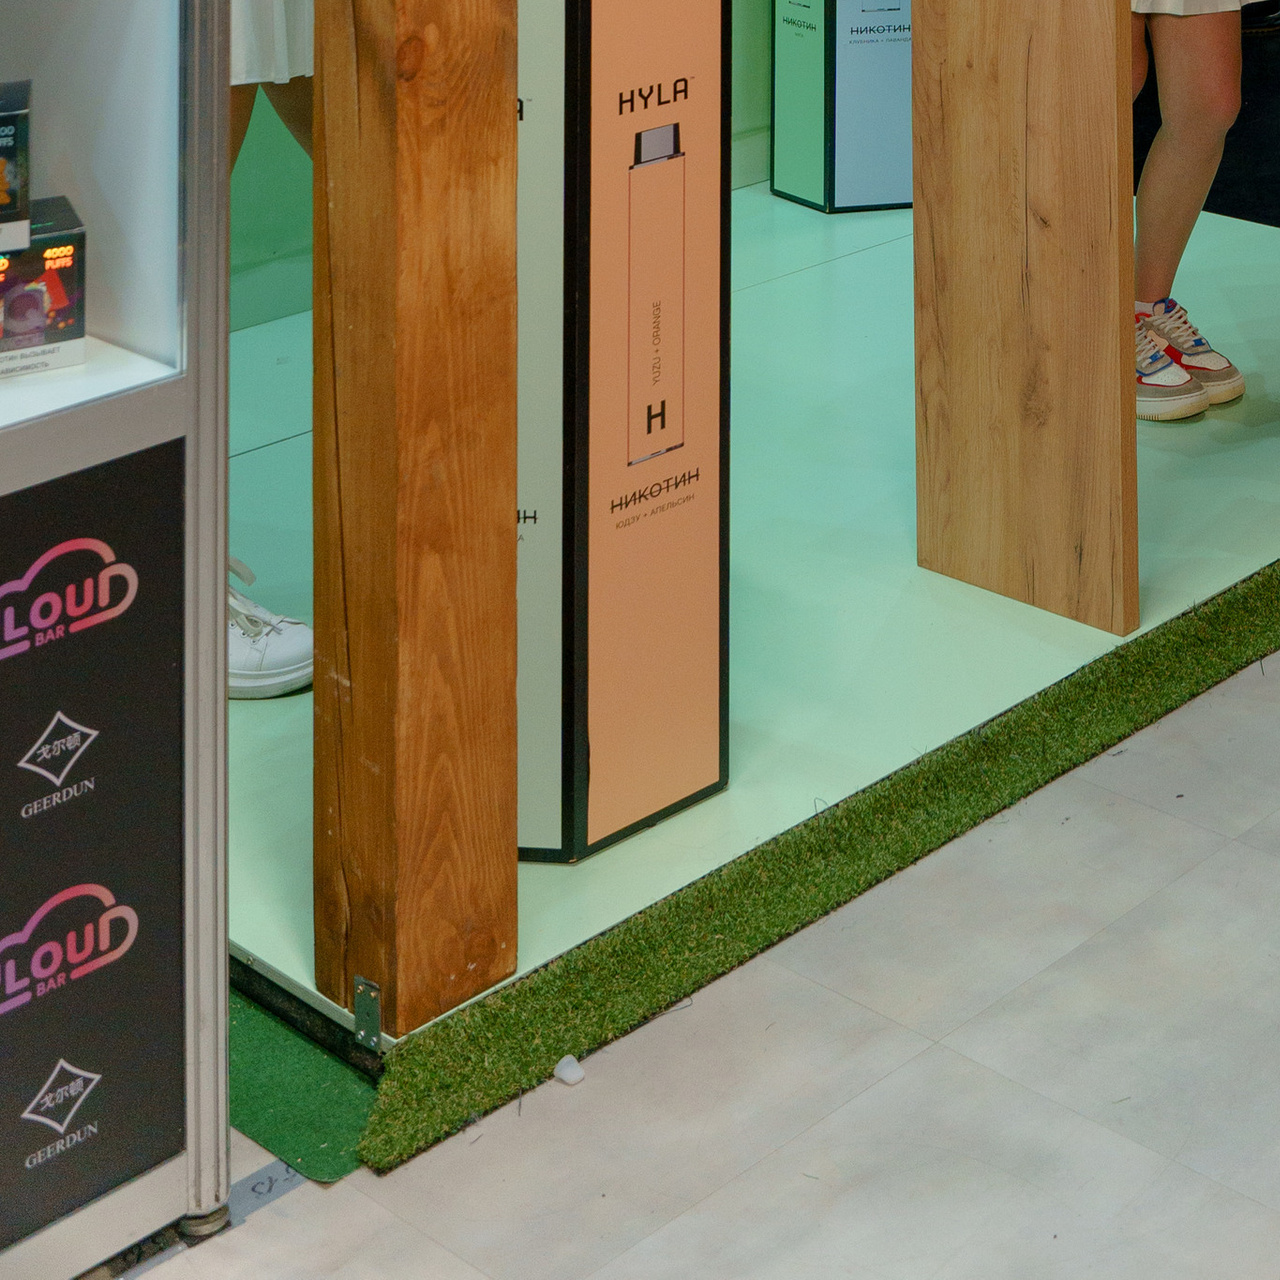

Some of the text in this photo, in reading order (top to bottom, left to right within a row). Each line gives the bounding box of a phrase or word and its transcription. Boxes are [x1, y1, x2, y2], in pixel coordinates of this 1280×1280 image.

[782, 16, 817, 32] НИКОТИН
[850, 24, 911, 35] НИКОТИН
[618, 77, 690, 116] HYLA
[43, 245, 75, 259] 4000
[44, 257, 74, 270] PUFFS
[652, 299, 662, 346] ORANGE
[0, 362, 50, 375] АВИСИМОСТЬ
[652, 356, 662, 386] YUZU
[609, 467, 700, 514] НИКОТИН
[615, 514, 641, 530] ЮДЗУ
[649, 493, 695, 517] АПЕЛЬСИН
[0, 562, 139, 642] LOUD
[34, 623, 66, 648] BAR
[20, 776, 96, 819] GEERDUN
[0, 904, 139, 995] LOUD
[36, 972, 67, 998] BAR
[24, 1120, 99, 1171] GEERDUN
